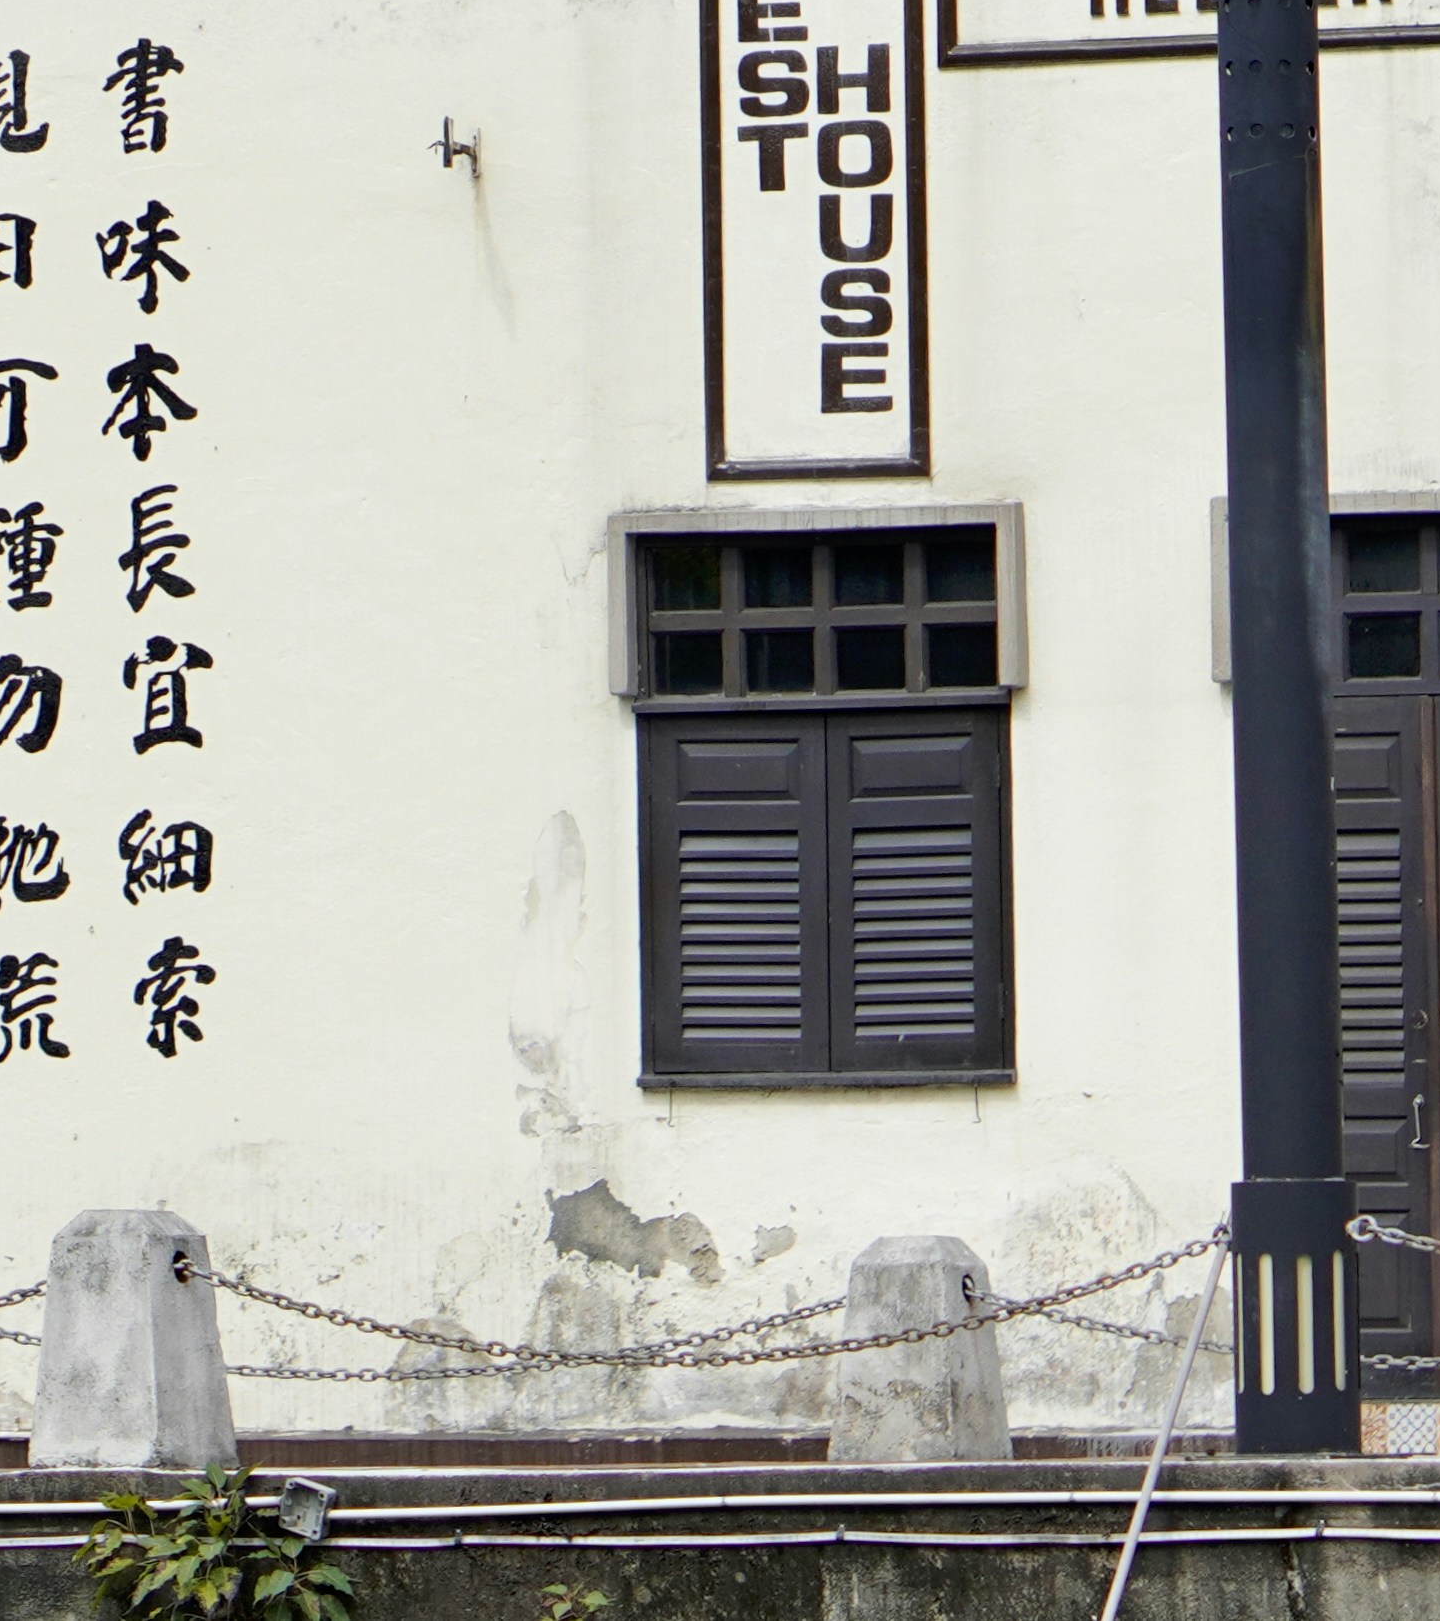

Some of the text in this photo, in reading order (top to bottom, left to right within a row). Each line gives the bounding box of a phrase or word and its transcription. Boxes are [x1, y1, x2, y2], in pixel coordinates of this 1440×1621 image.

[95, 37, 218, 1060] 書味本長宜細索
[817, 44, 894, 415] HOUSE
